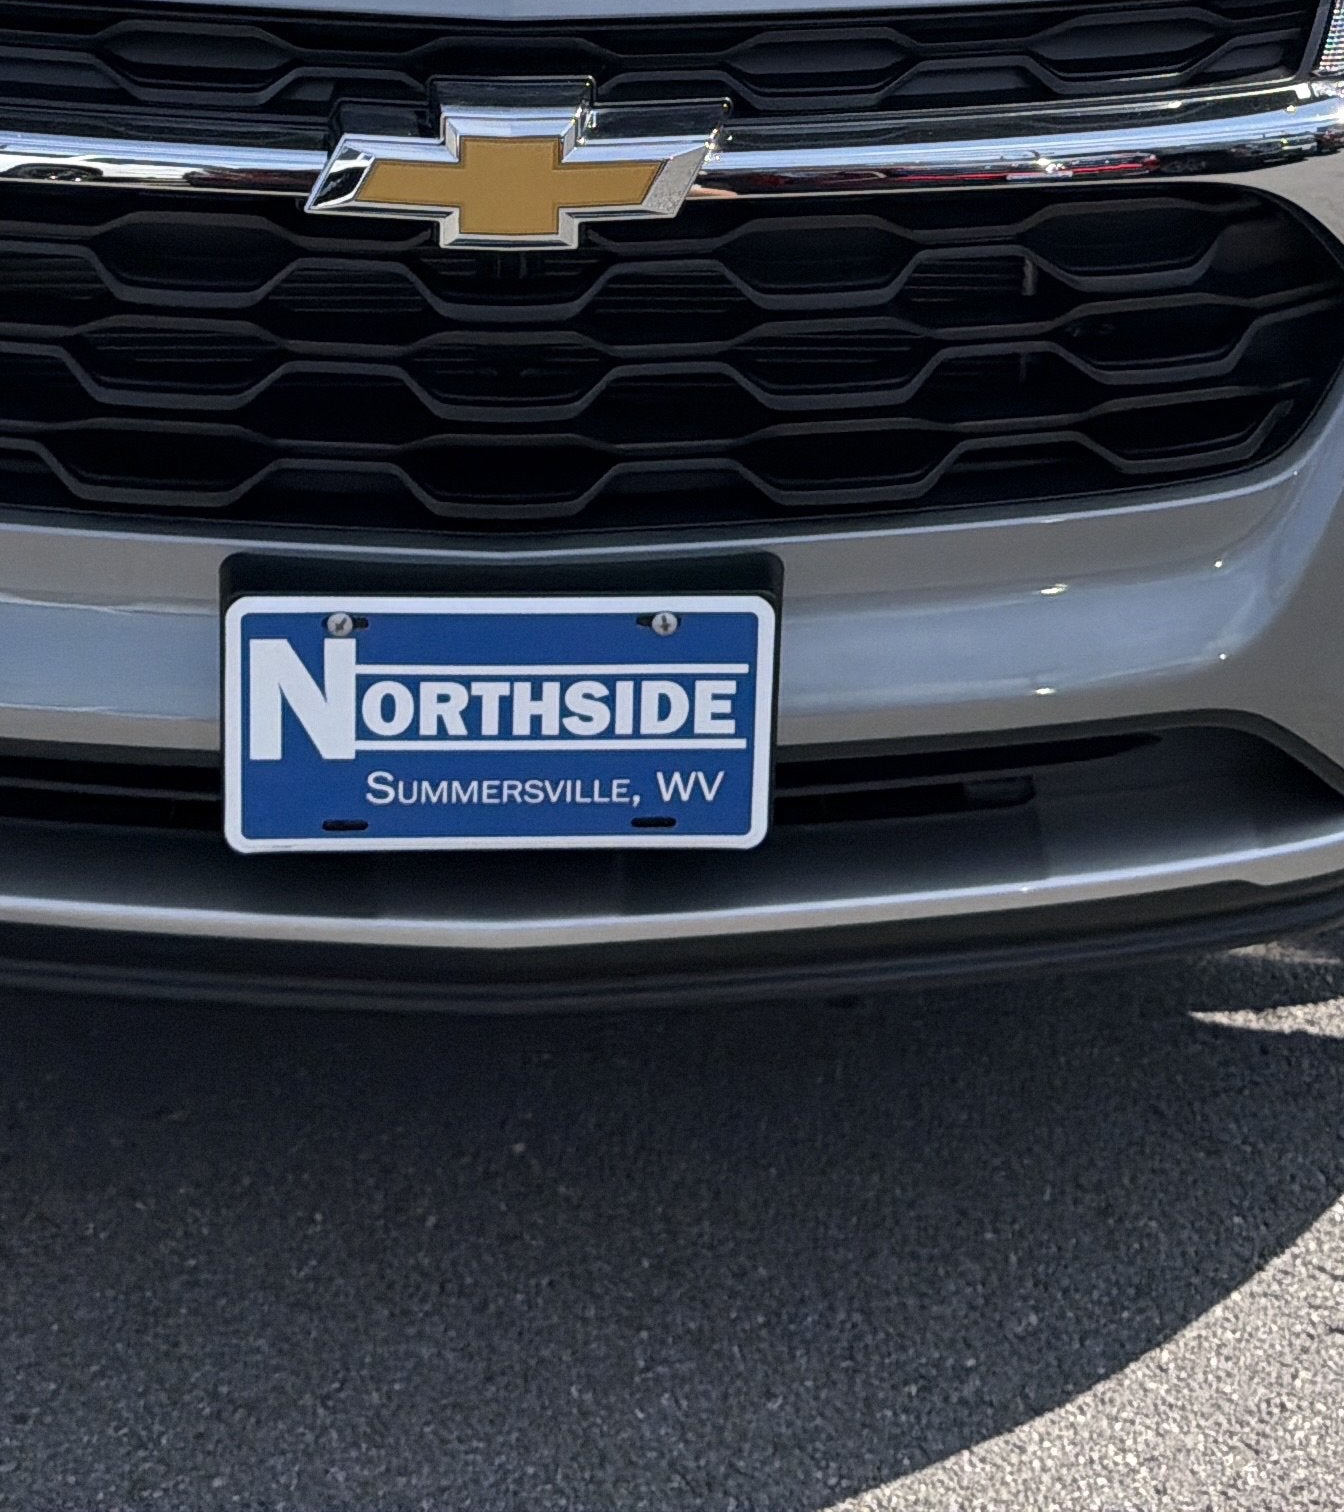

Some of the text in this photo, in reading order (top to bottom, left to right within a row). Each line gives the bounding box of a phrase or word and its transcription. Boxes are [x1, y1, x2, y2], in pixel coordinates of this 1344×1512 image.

[249, 637, 737, 761] NORTHSIDE
[365, 770, 725, 808] SUMMERSVILLE, WV
